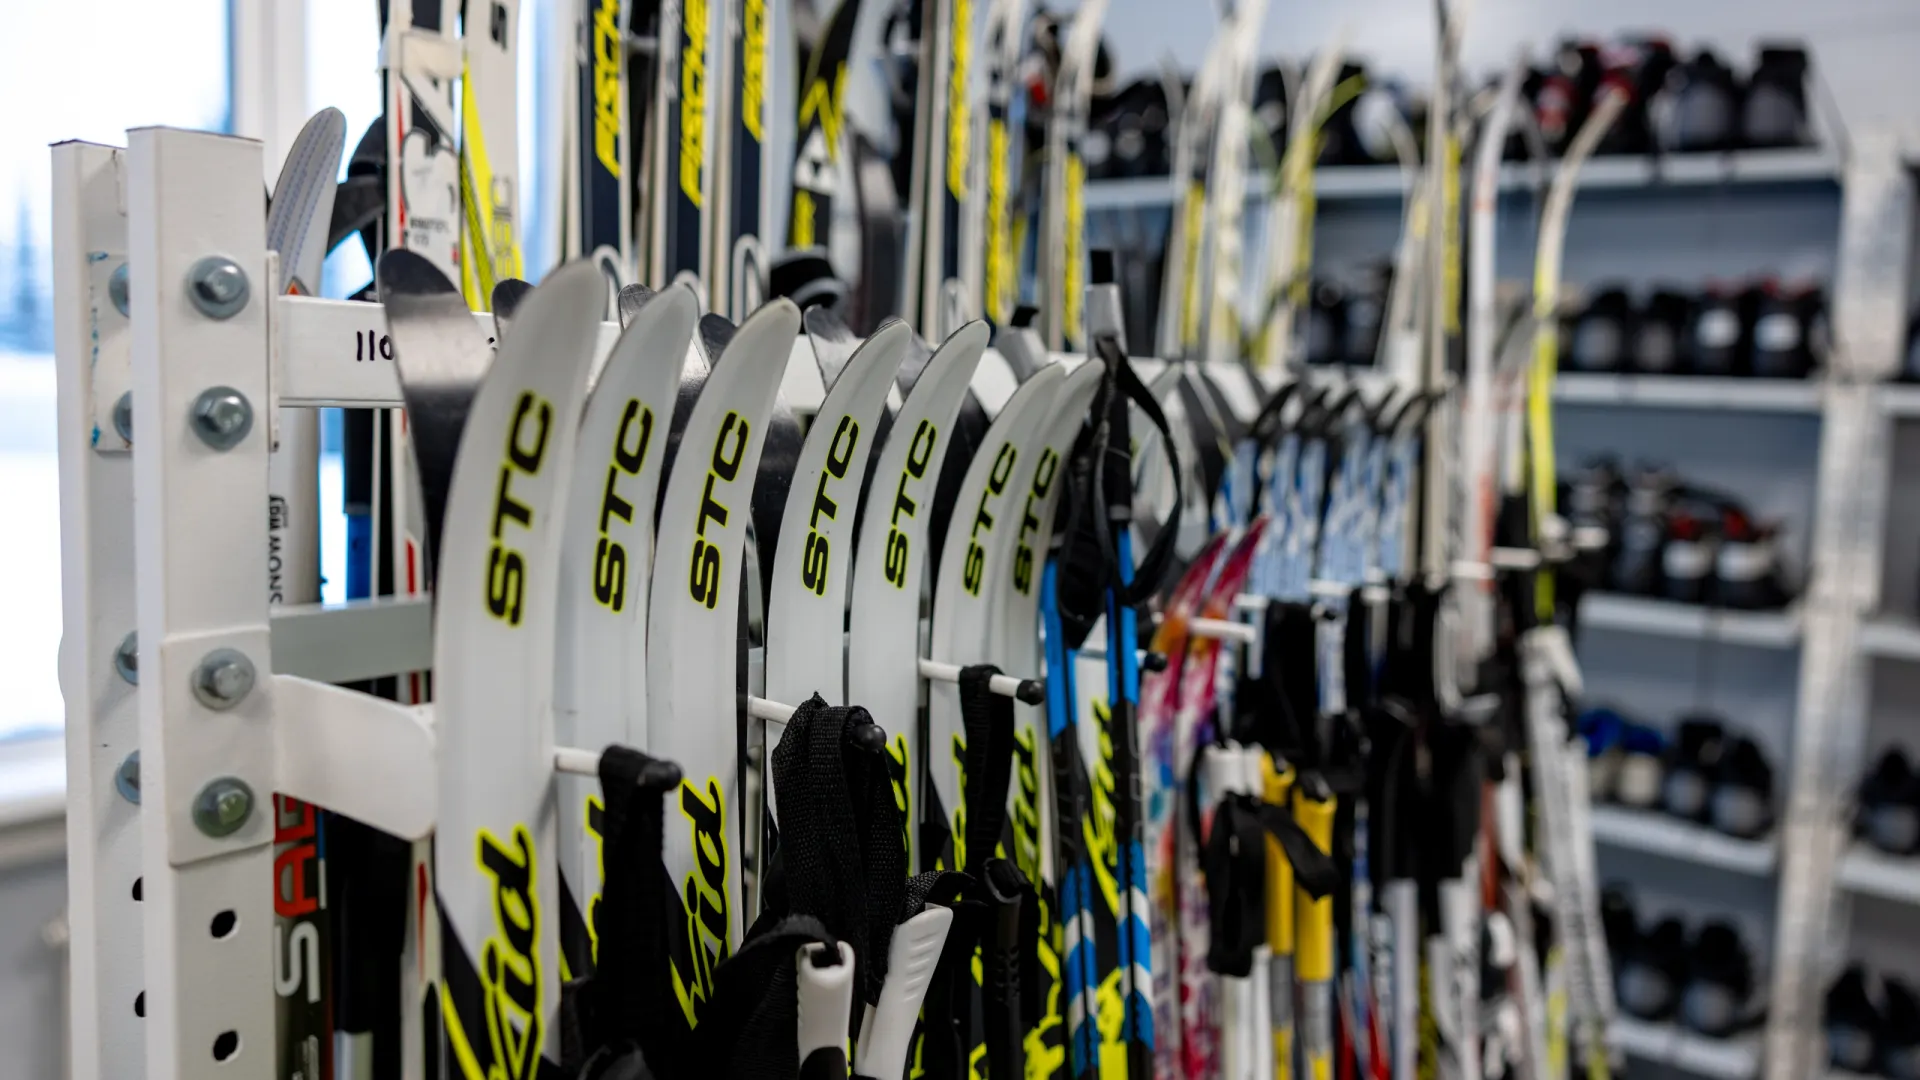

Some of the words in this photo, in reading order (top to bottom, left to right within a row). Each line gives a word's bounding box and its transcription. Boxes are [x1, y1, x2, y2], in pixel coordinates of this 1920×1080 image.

[486, 390, 553, 627] STC
[593, 397, 655, 615] STC
[689, 410, 750, 611] STC
[802, 414, 860, 597] STC
[884, 418, 938, 589] STC
[964, 441, 1018, 597] STC
[1012, 446, 1059, 597] STC
